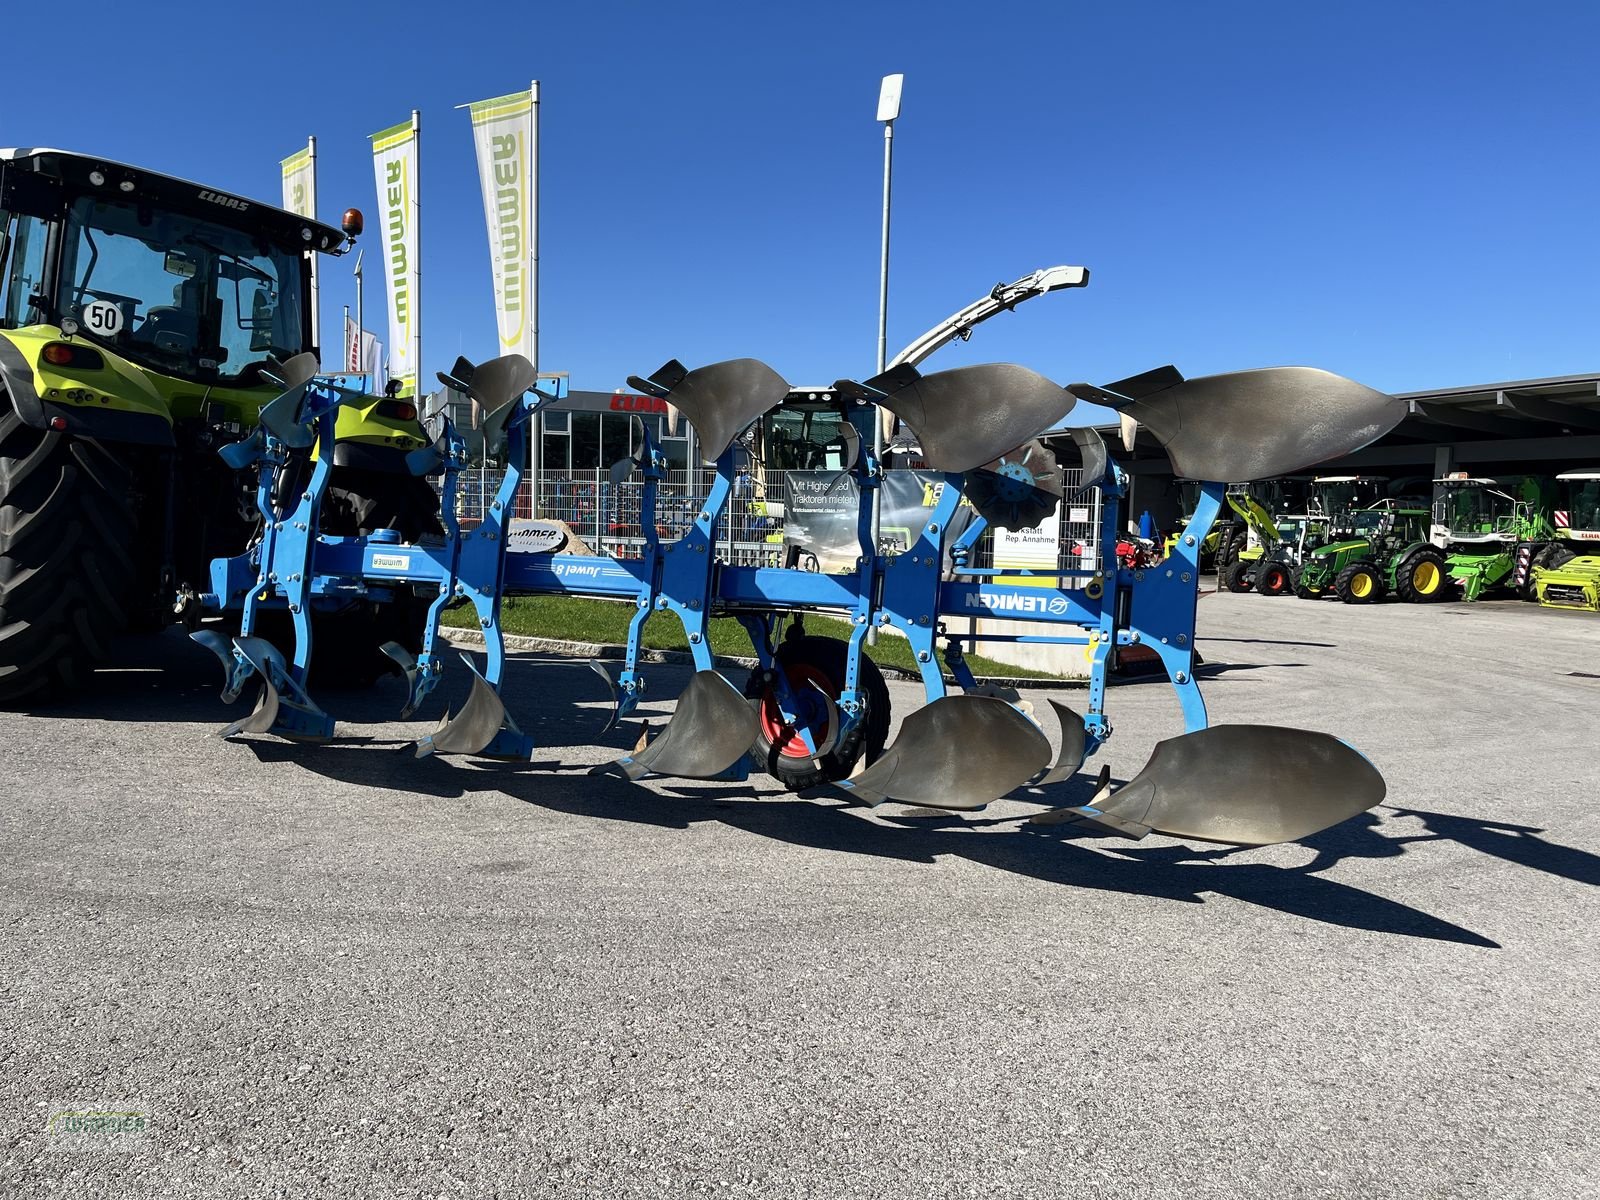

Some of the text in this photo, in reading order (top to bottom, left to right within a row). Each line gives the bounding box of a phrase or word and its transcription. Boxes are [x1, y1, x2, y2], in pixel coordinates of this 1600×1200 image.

[198, 190, 250, 211] CLAAS
[91, 305, 117, 331] 50
[609, 394, 668, 414] CLAA
[793, 481, 849, 493] Mit Highsed
[793, 494, 857, 504] Traktoren mieten.
[1005, 534, 1056, 543] Rep. Annahme
[374, 558, 403, 566] WIMMER
[556, 564, 601, 577] Juwel 8
[965, 591, 1047, 613] LEMKEN
